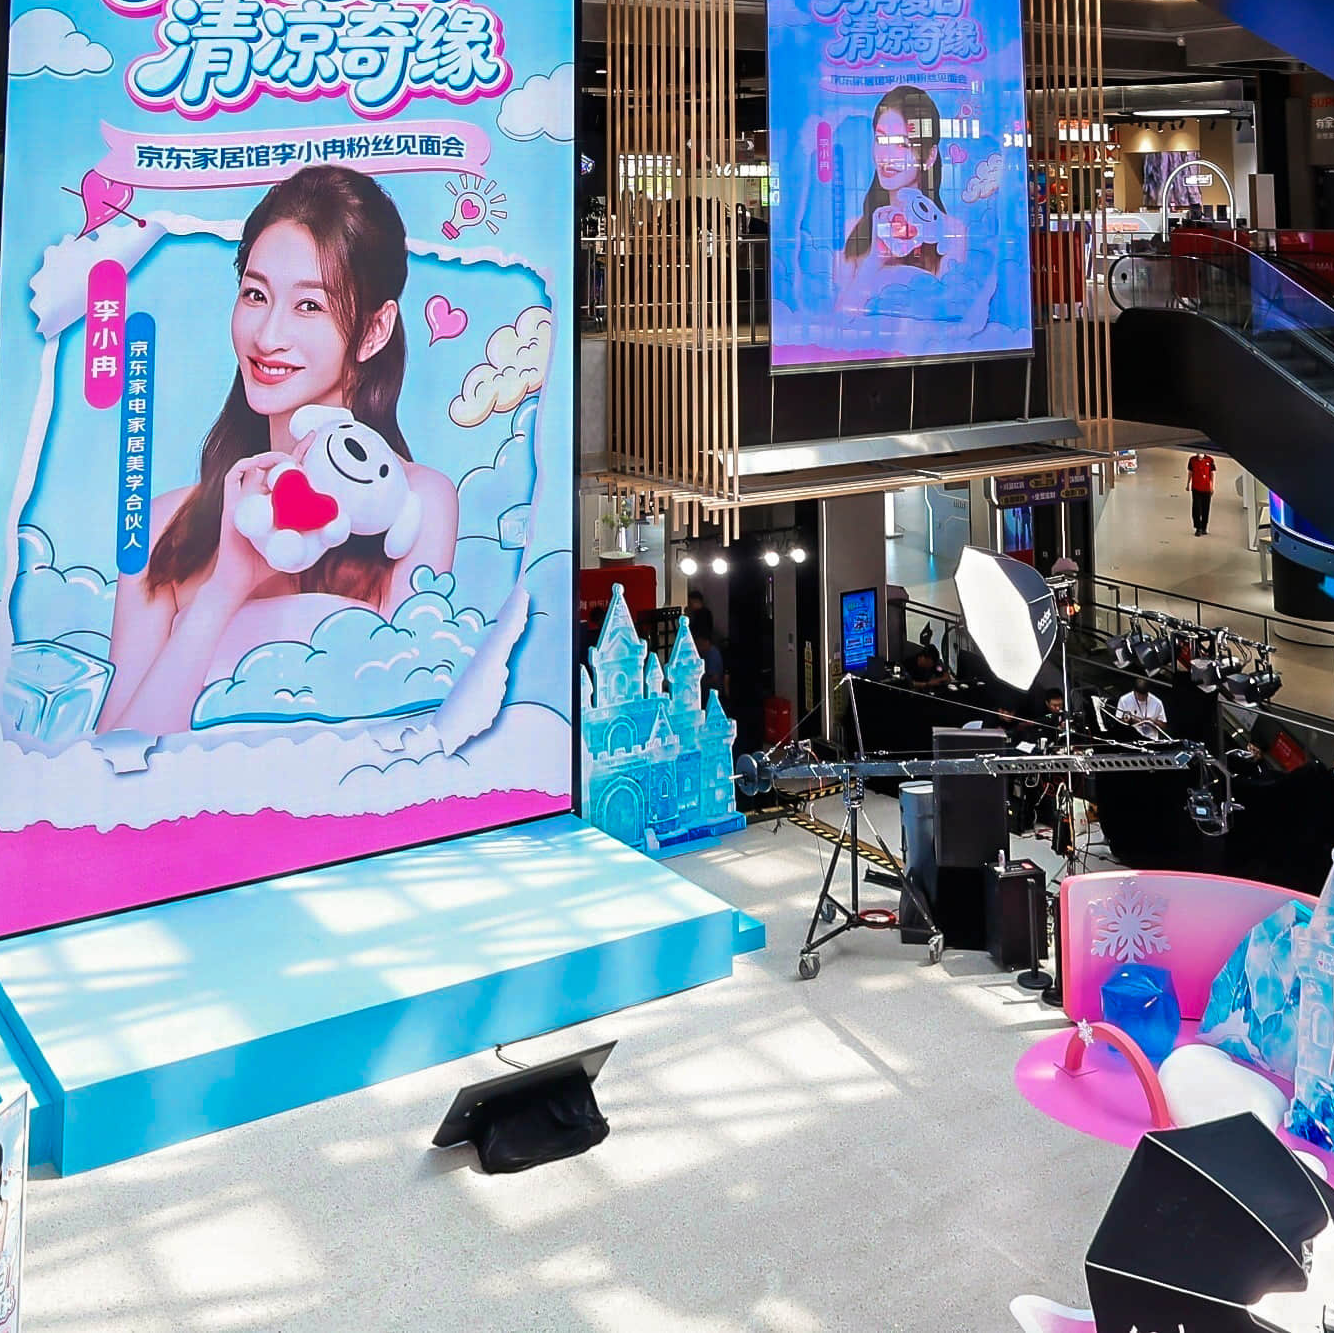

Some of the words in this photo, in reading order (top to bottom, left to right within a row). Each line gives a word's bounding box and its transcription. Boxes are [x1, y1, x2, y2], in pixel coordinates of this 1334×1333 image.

[828, 17, 984, 66] 清凉奇缘
[136, 133, 466, 170] 京东家居馆李小冉粉丝见面会
[90, 299, 120, 379] 李小冉
[123, 340, 149, 550] 京东家电家居美学合伙人
